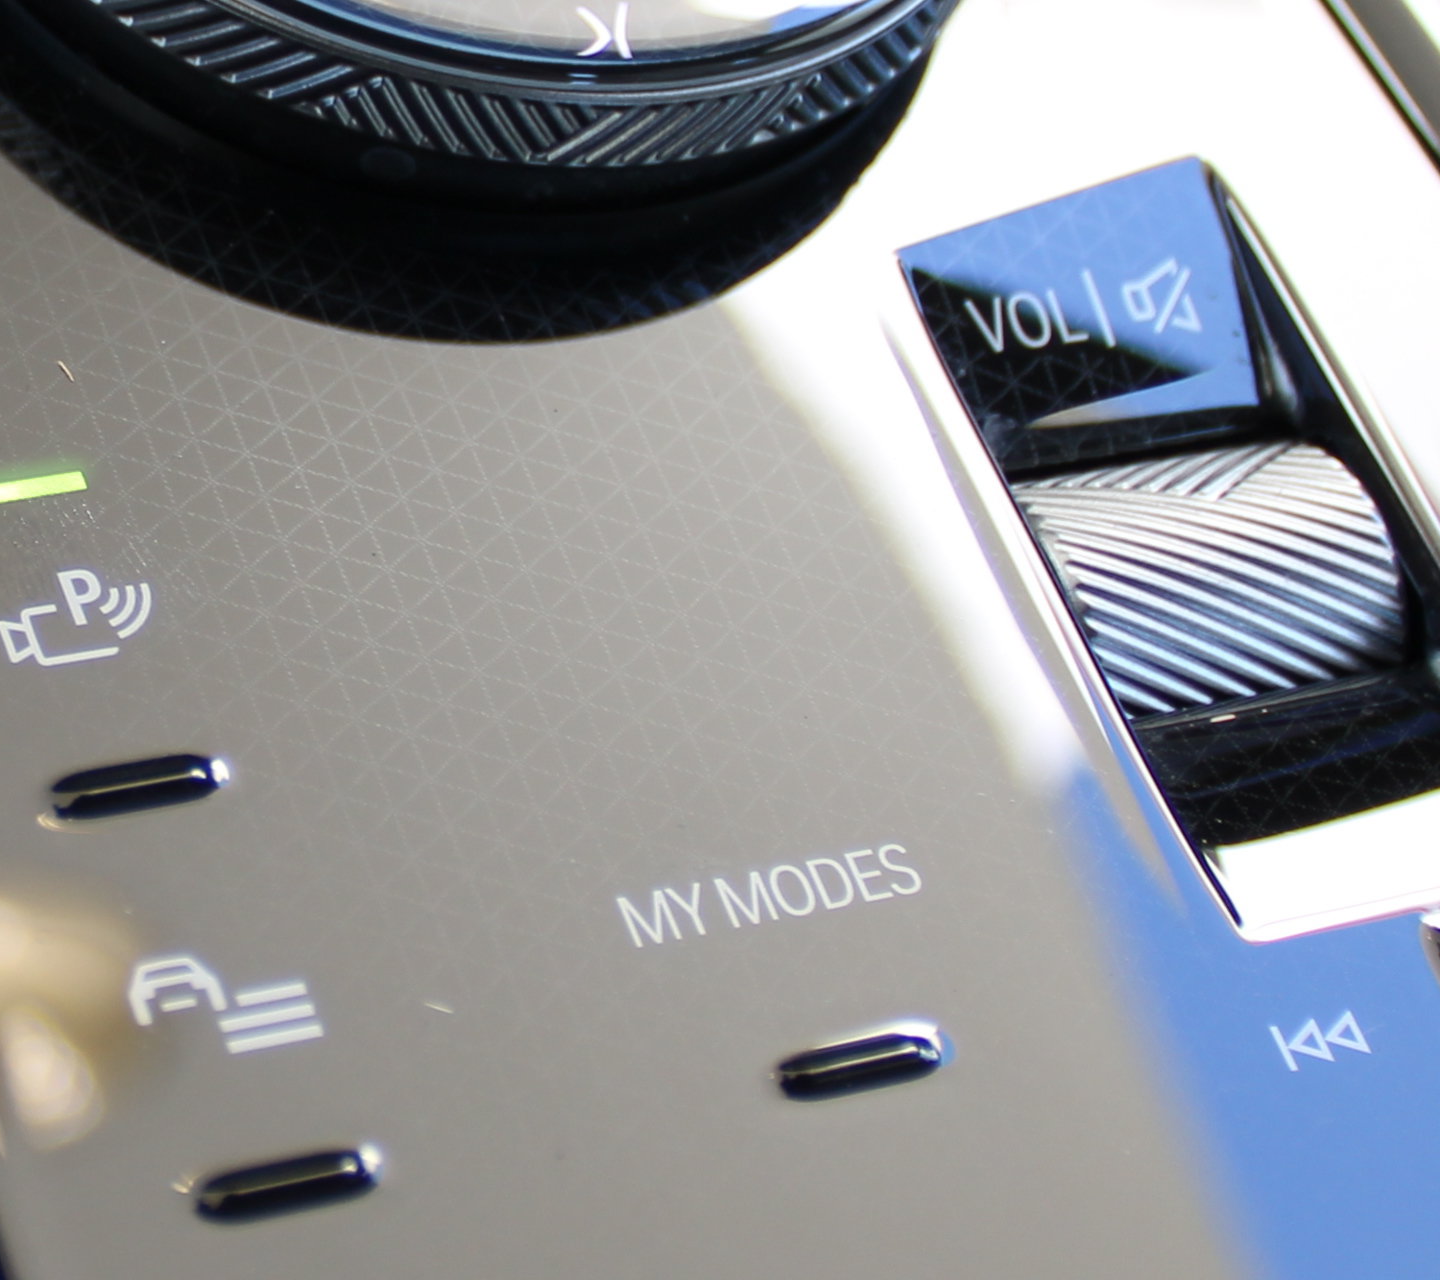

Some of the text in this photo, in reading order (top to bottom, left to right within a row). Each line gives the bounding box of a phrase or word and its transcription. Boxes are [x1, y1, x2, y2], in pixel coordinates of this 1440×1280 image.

[966, 289, 1088, 355] VOL
[616, 843, 922, 948] MY MODES
